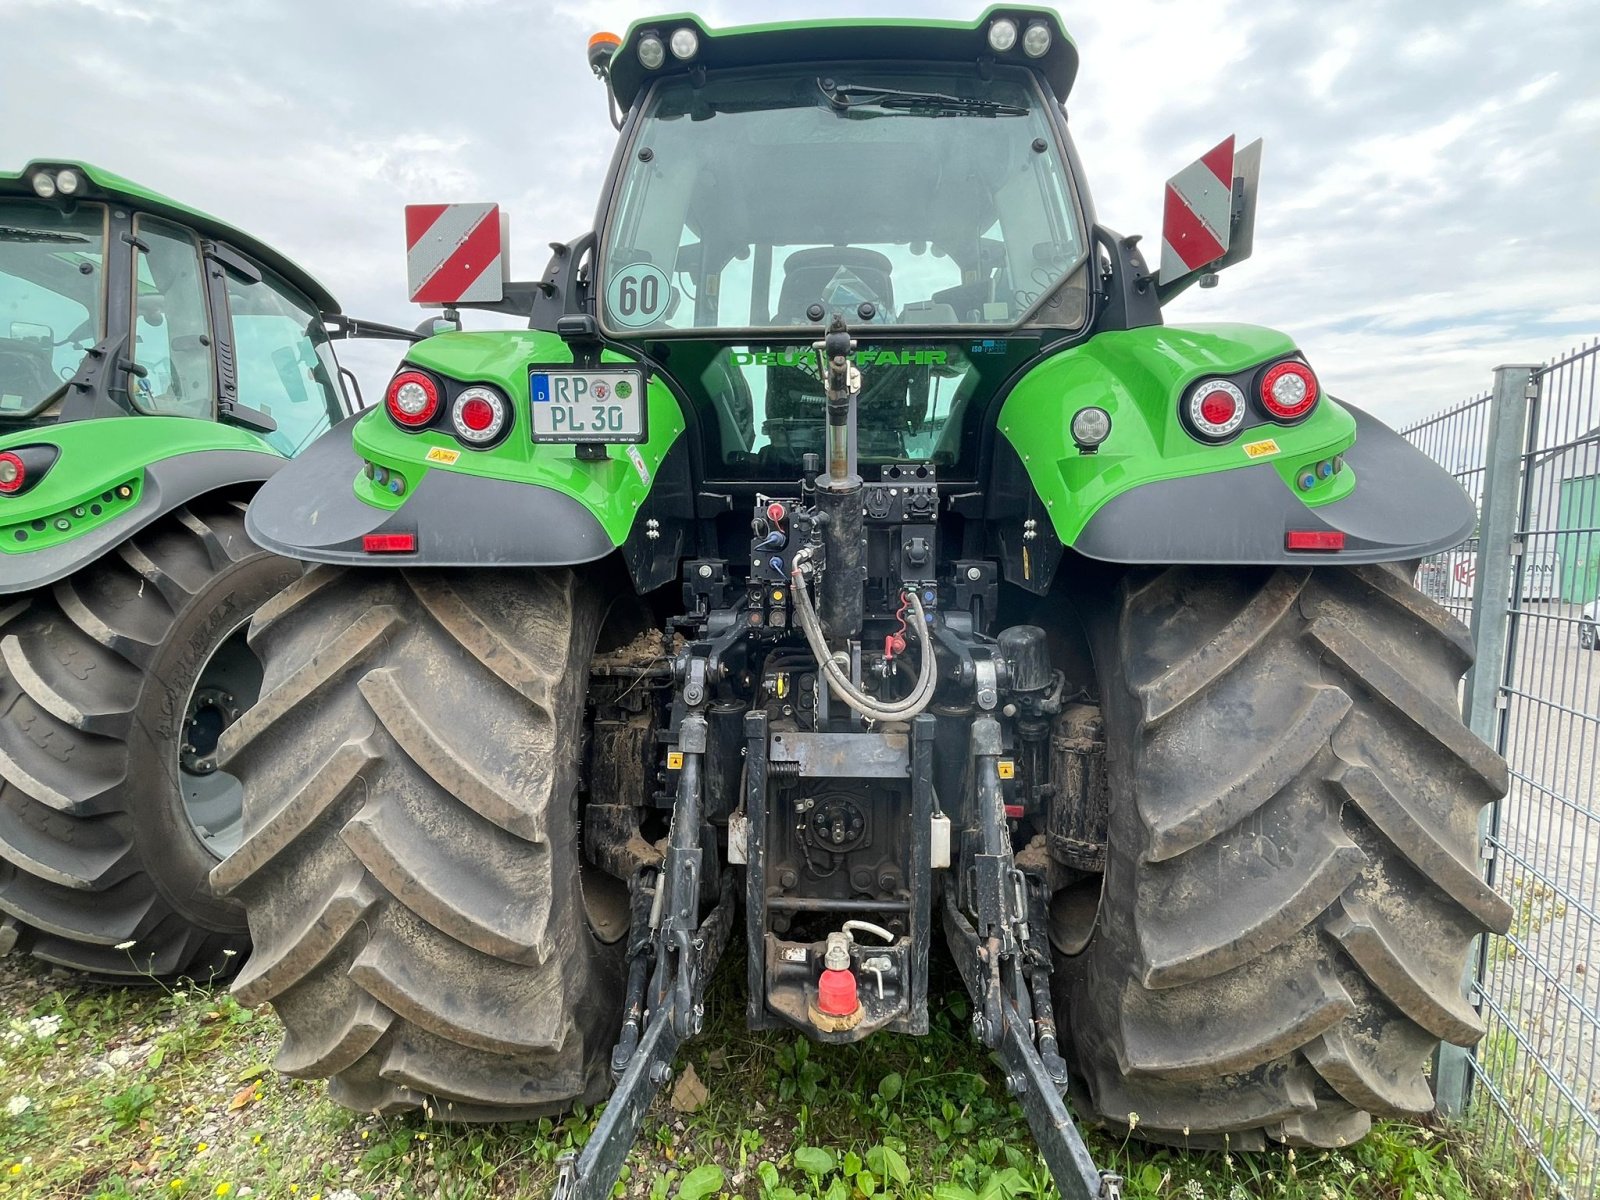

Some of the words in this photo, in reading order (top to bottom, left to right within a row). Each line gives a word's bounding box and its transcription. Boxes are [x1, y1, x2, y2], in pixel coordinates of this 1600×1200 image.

[619, 274, 659, 316] 60
[538, 391, 545, 400] D
[554, 377, 588, 403] RP
[550, 406, 585, 431] PL
[591, 406, 623, 431] 30
